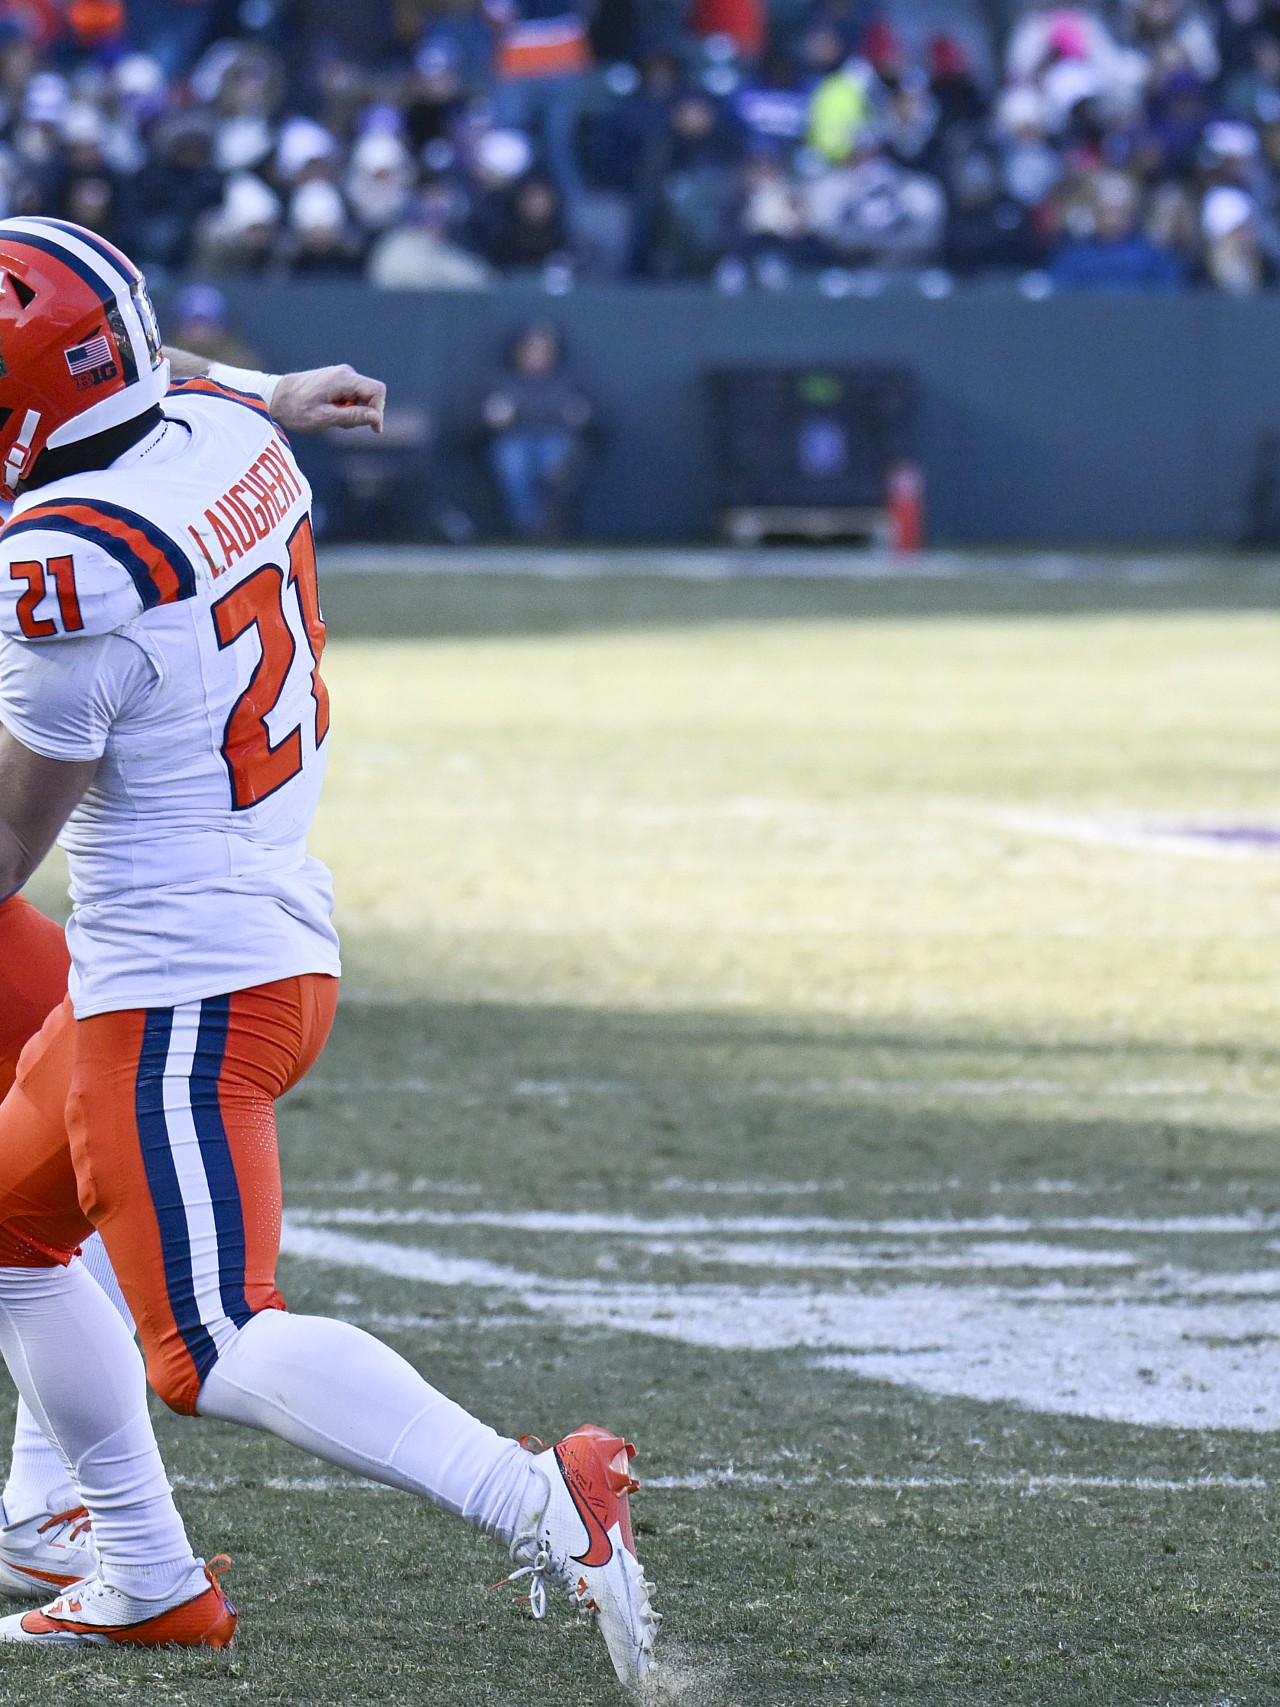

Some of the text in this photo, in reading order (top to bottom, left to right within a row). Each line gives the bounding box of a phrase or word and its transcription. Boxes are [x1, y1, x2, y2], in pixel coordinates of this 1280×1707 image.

[187, 439, 303, 580] LAUGHERY
[9, 554, 85, 639] 21
[211, 510, 331, 812] 21
